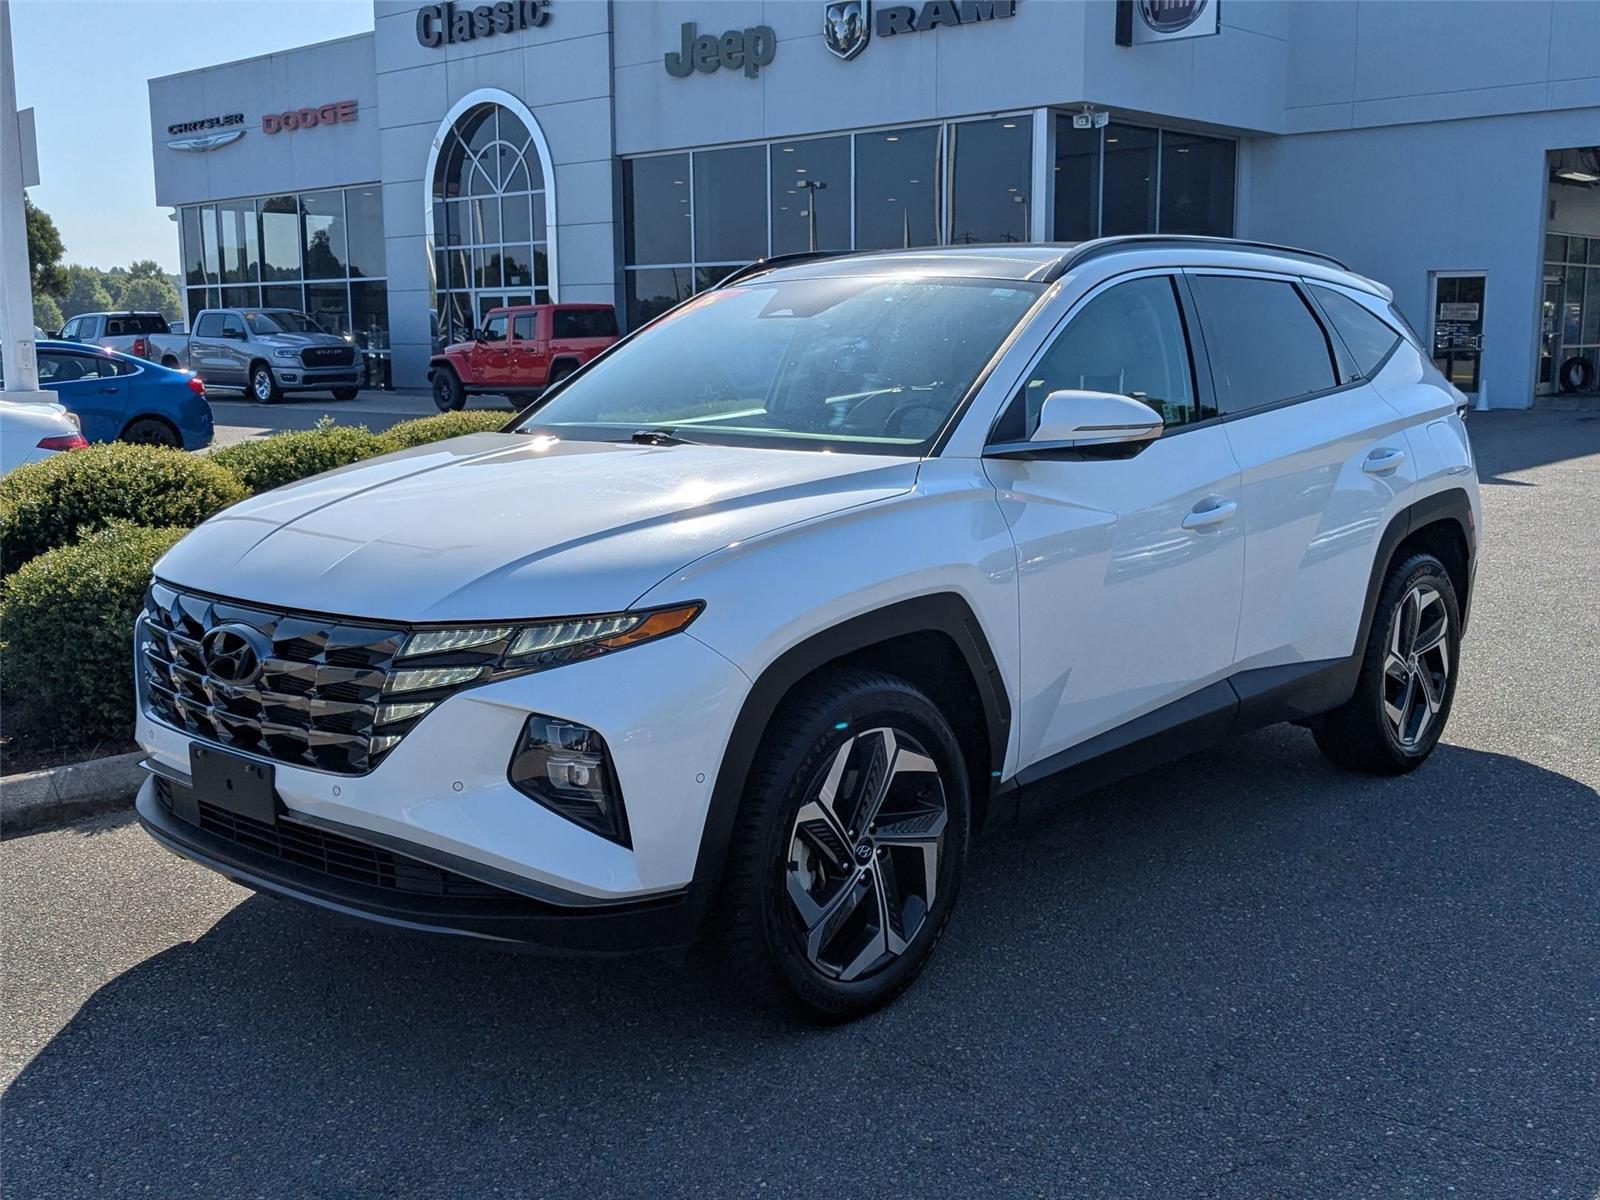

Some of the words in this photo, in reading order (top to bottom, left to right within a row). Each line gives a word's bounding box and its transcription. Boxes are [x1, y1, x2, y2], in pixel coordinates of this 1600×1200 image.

[416, 0, 549, 48] Classic
[876, 0, 1015, 37] RAM
[665, 22, 776, 78] Jeep
[167, 113, 245, 135] CHRYSLER
[262, 101, 359, 135] DODGE
